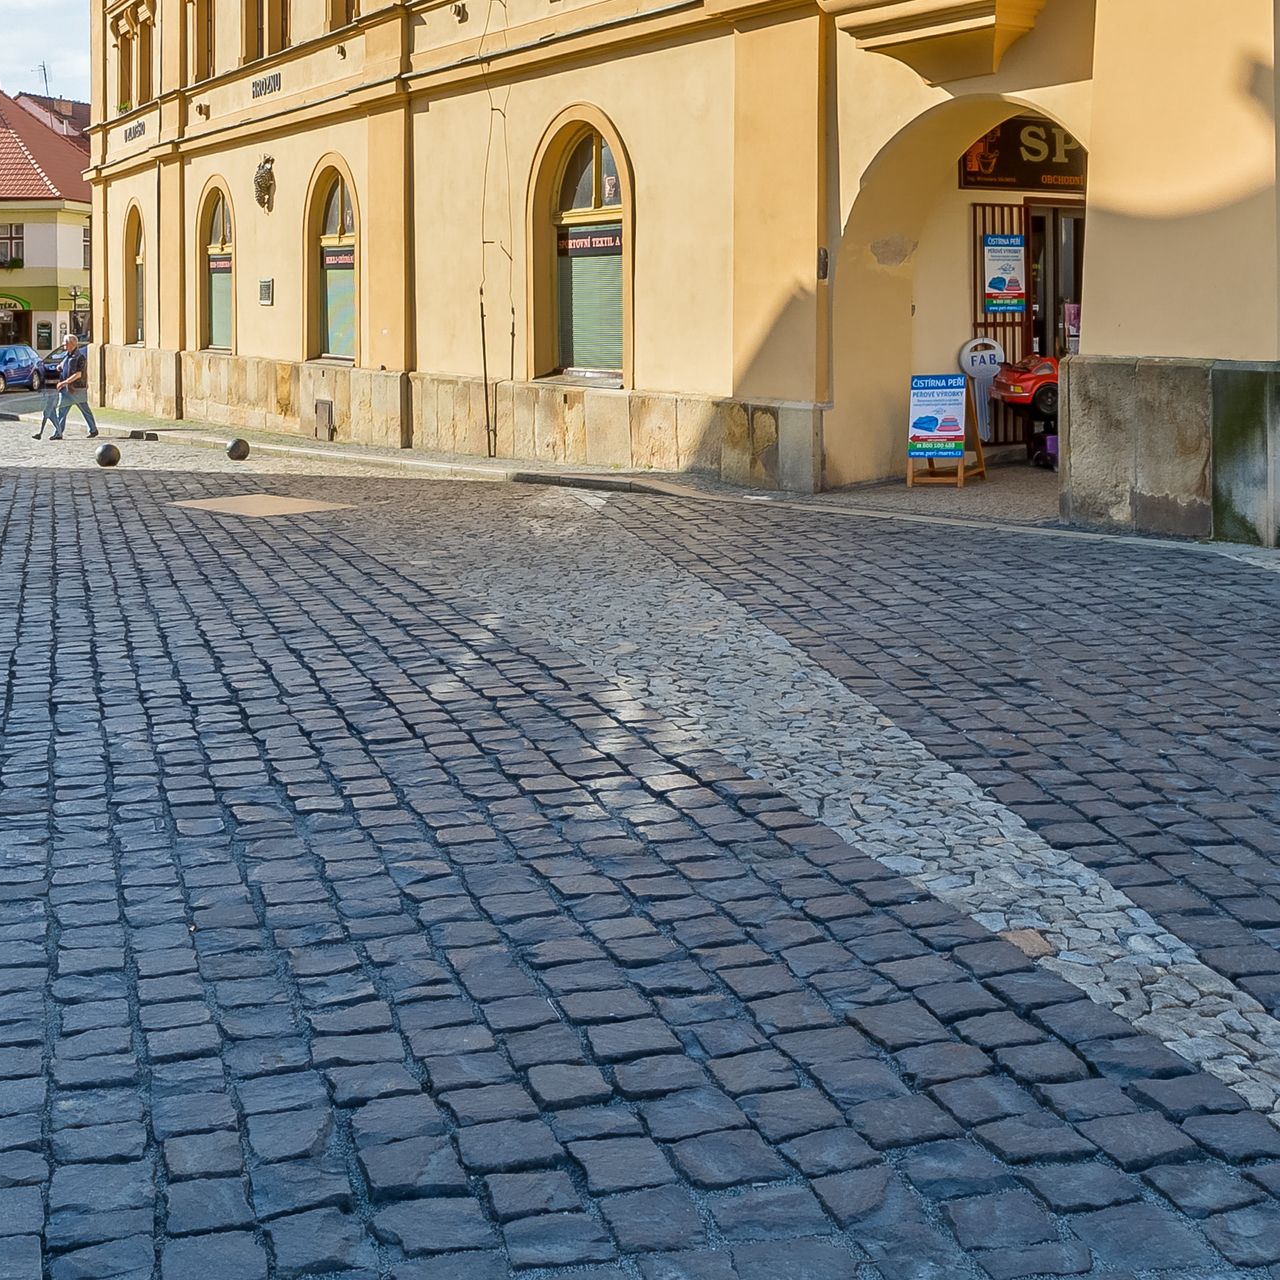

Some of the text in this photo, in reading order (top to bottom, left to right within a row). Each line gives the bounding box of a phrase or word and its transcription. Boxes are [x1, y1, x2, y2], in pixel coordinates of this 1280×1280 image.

[1041, 174, 1084, 185] OBCHODNÍ
[558, 236, 621, 249] SPORTOVNÍ TEXTIL A
[970, 353, 997, 367] FAB
[912, 376, 964, 388] ČISTÍRNA PEŘÍ
